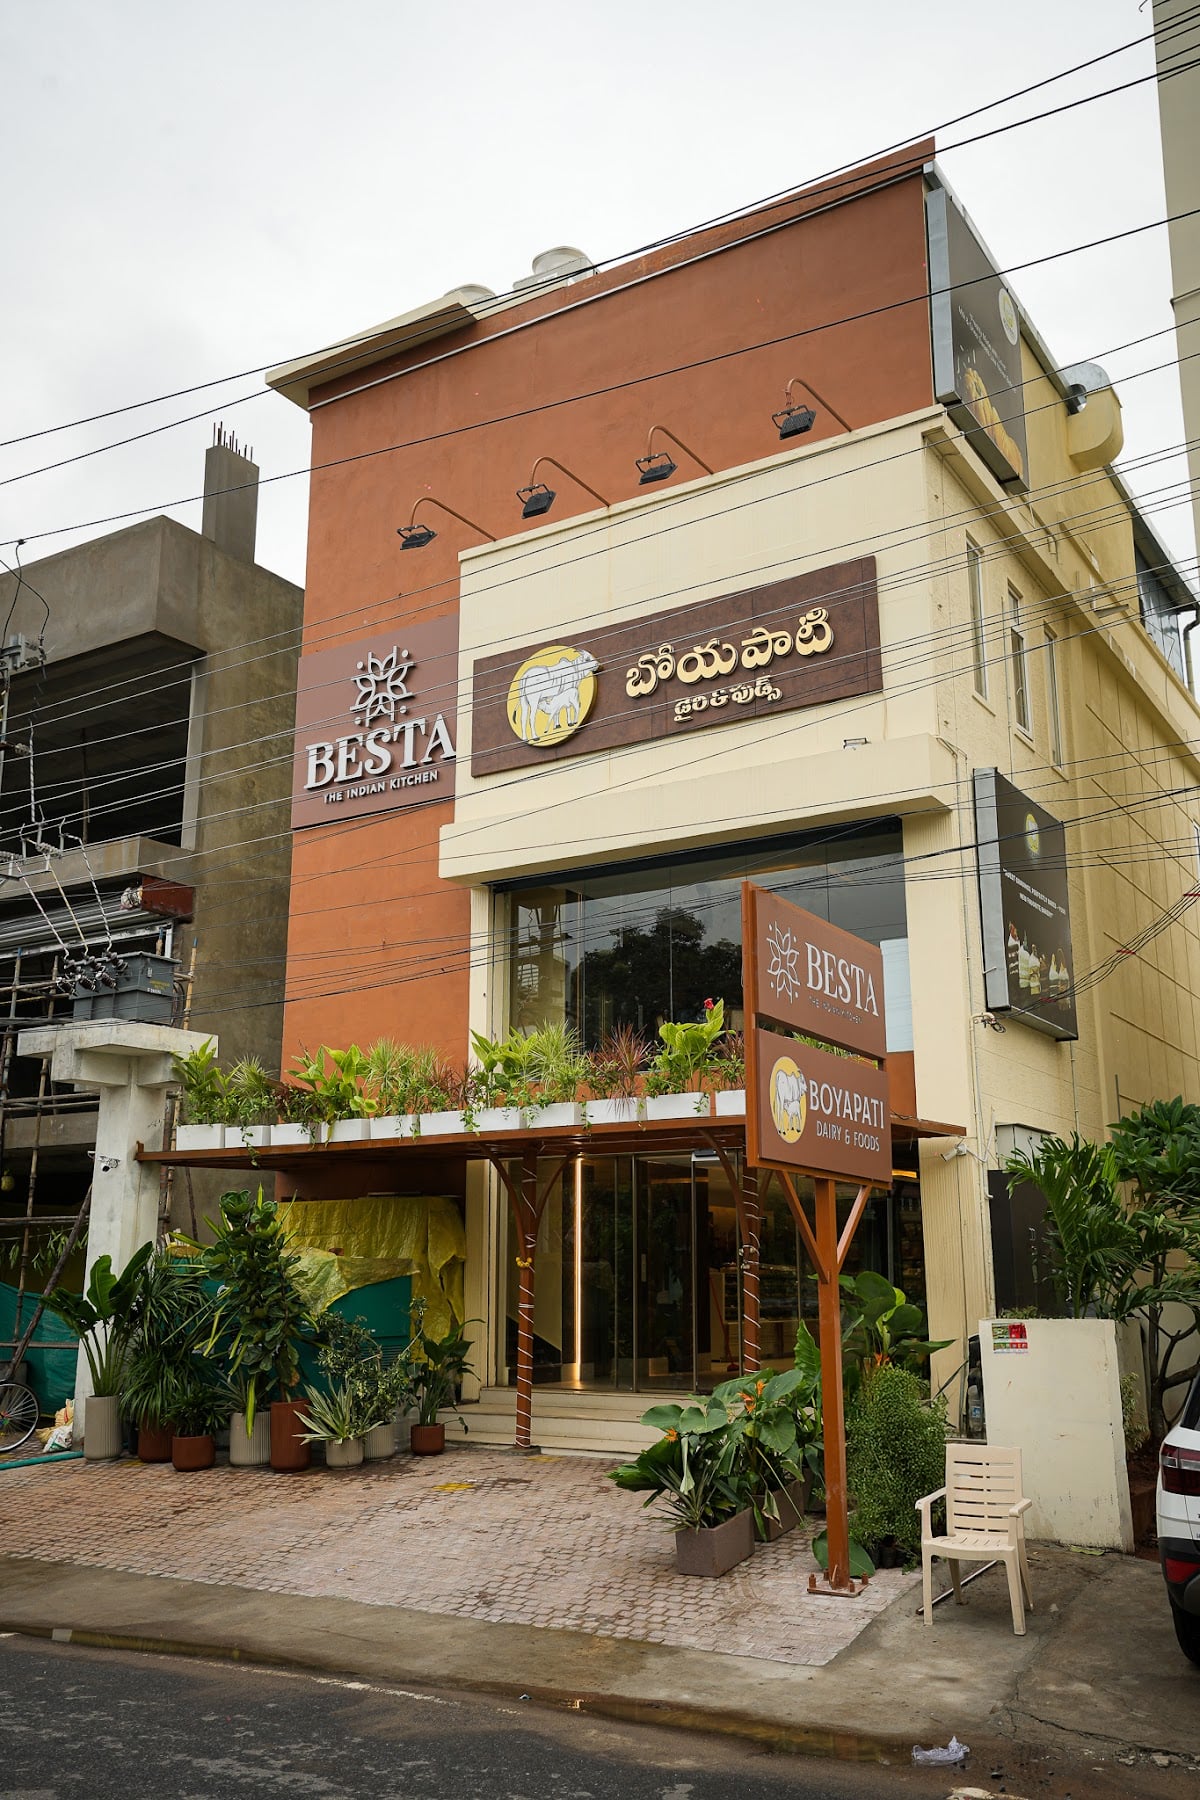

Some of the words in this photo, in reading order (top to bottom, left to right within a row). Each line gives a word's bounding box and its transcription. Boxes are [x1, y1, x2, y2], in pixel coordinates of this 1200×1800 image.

[626, 606, 834, 698] బోయపాటి
[304, 713, 457, 790] BESTA
[323, 791, 343, 804] THE
[347, 781, 386, 799] INDIAN
[390, 770, 438, 790] KITCHEN
[804, 942, 879, 1017] BESTA
[809, 1079, 884, 1130] BOYAPATI
[816, 1120, 842, 1141] DAIRY
[844, 1128, 851, 1145] &
[853, 1131, 880, 1152] FOODS
